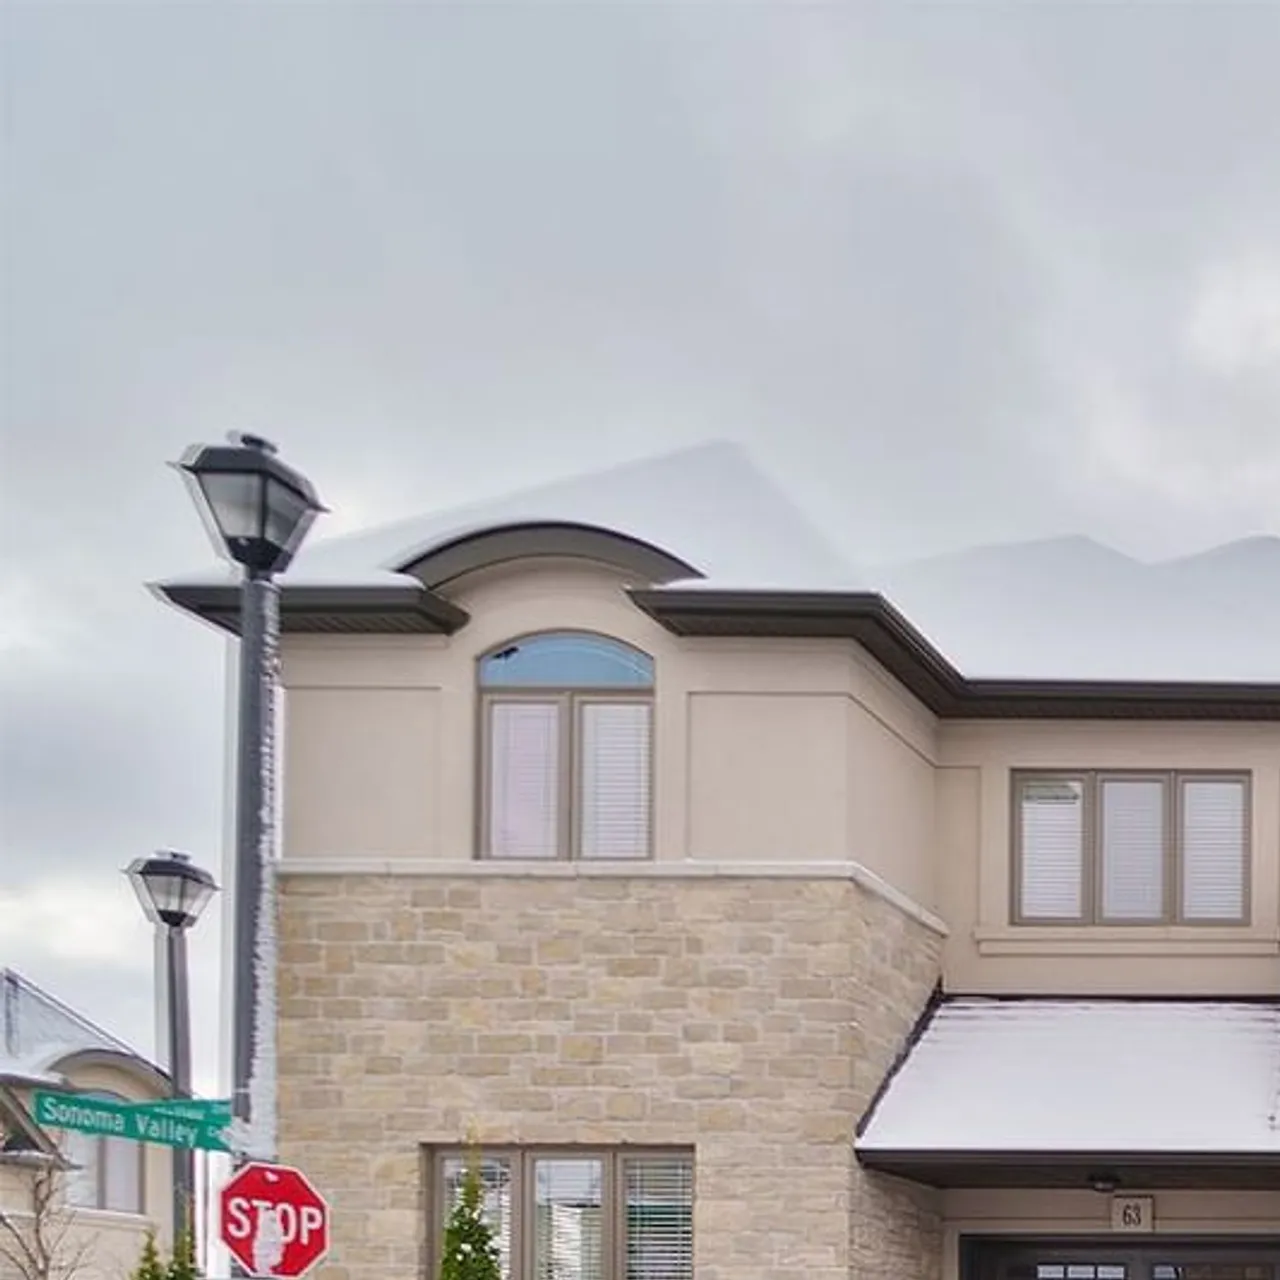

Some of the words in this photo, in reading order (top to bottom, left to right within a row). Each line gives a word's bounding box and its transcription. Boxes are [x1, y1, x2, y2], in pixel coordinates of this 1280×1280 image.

[43, 1096, 126, 1132] Sonoma
[135, 1113, 199, 1148] Valley
[227, 1197, 323, 1246] STOP
[1123, 1204, 1141, 1226] 63
